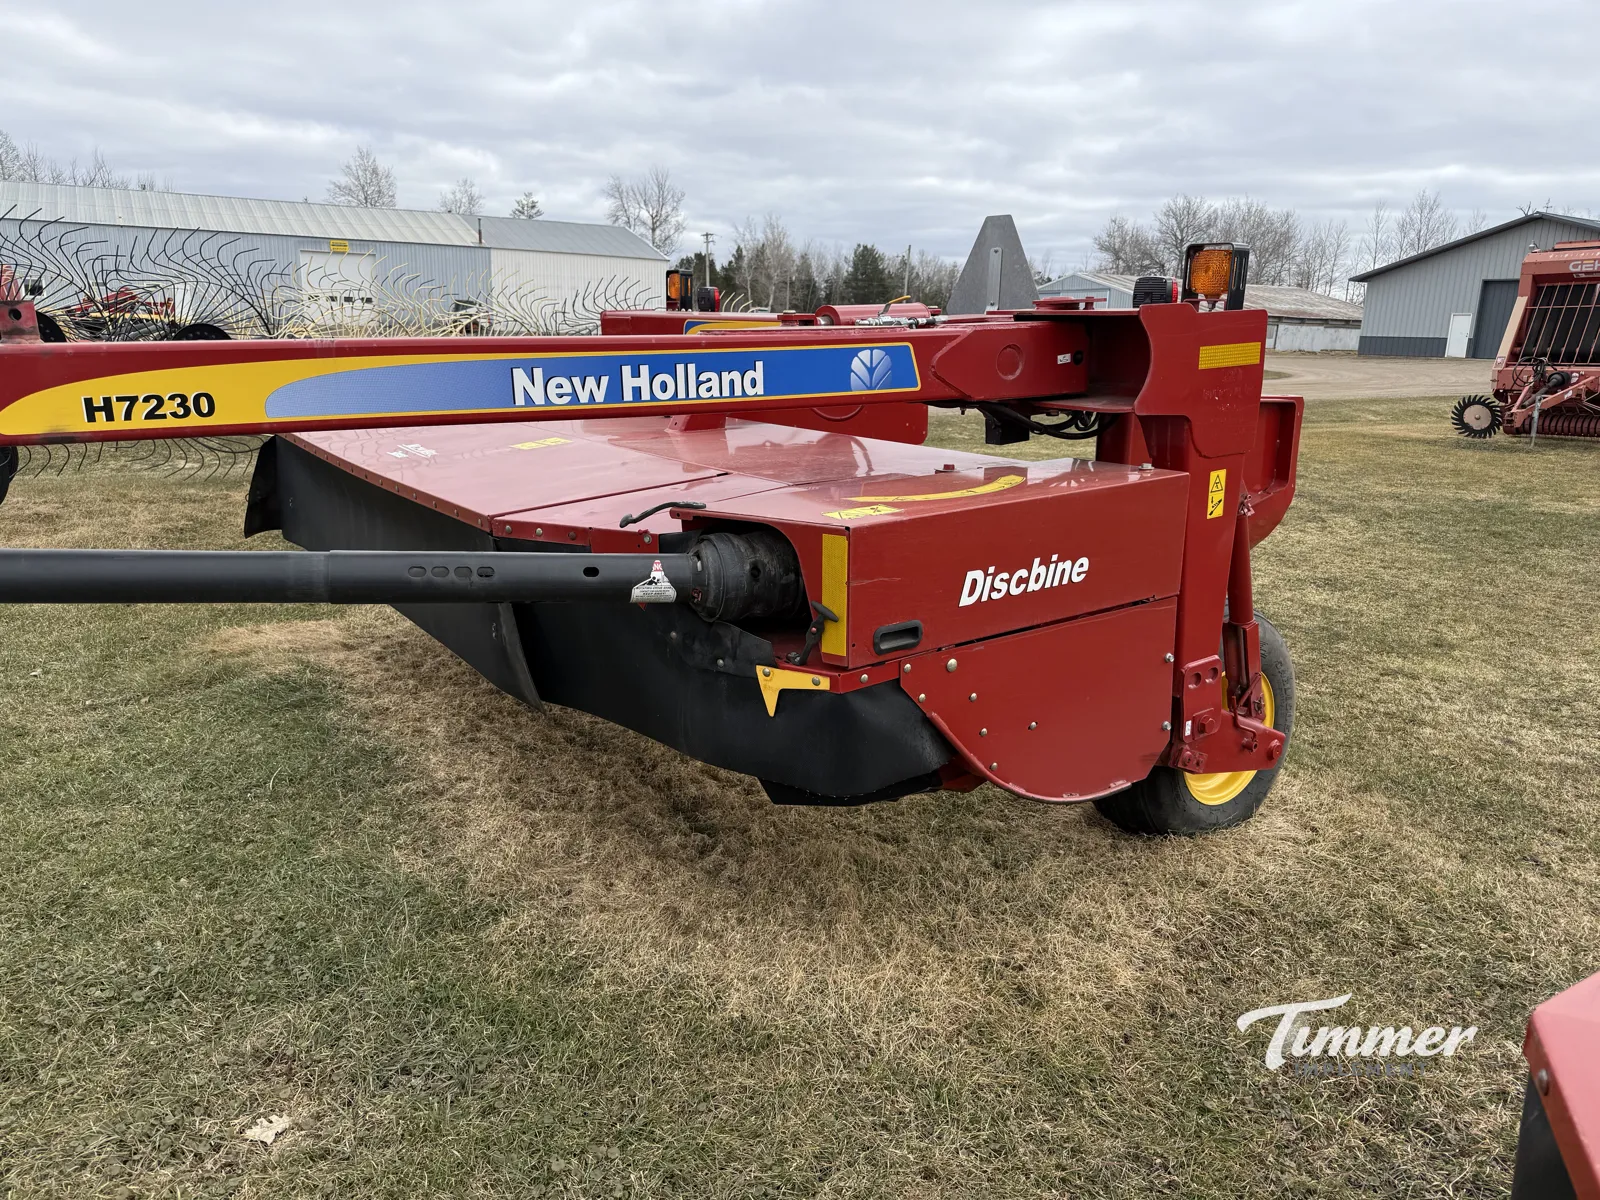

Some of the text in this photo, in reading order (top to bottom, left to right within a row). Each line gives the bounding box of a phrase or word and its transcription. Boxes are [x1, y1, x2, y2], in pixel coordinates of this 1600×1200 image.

[512, 360, 765, 407] New Holland
[83, 391, 216, 424] H7230
[958, 554, 1090, 608] Discbine
